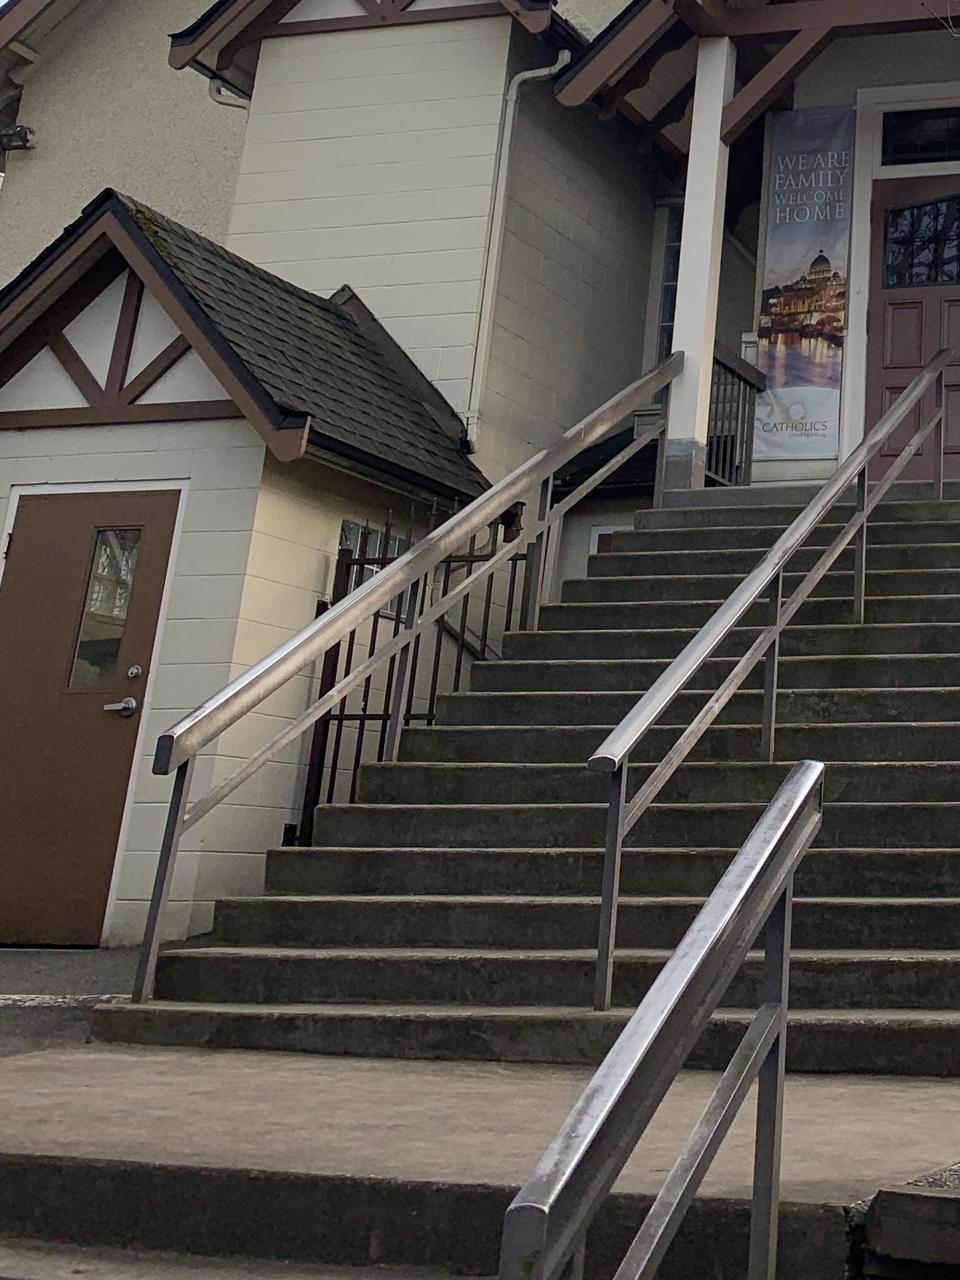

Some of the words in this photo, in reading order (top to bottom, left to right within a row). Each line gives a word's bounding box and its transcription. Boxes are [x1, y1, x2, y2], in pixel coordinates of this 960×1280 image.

[778, 154, 807, 171] WE
[813, 151, 849, 169] ARE
[775, 169, 848, 190] FAMILY
[775, 189, 846, 206] WELCOME
[776, 202, 845, 224] HOME
[762, 421, 828, 433] CATHOLICS
